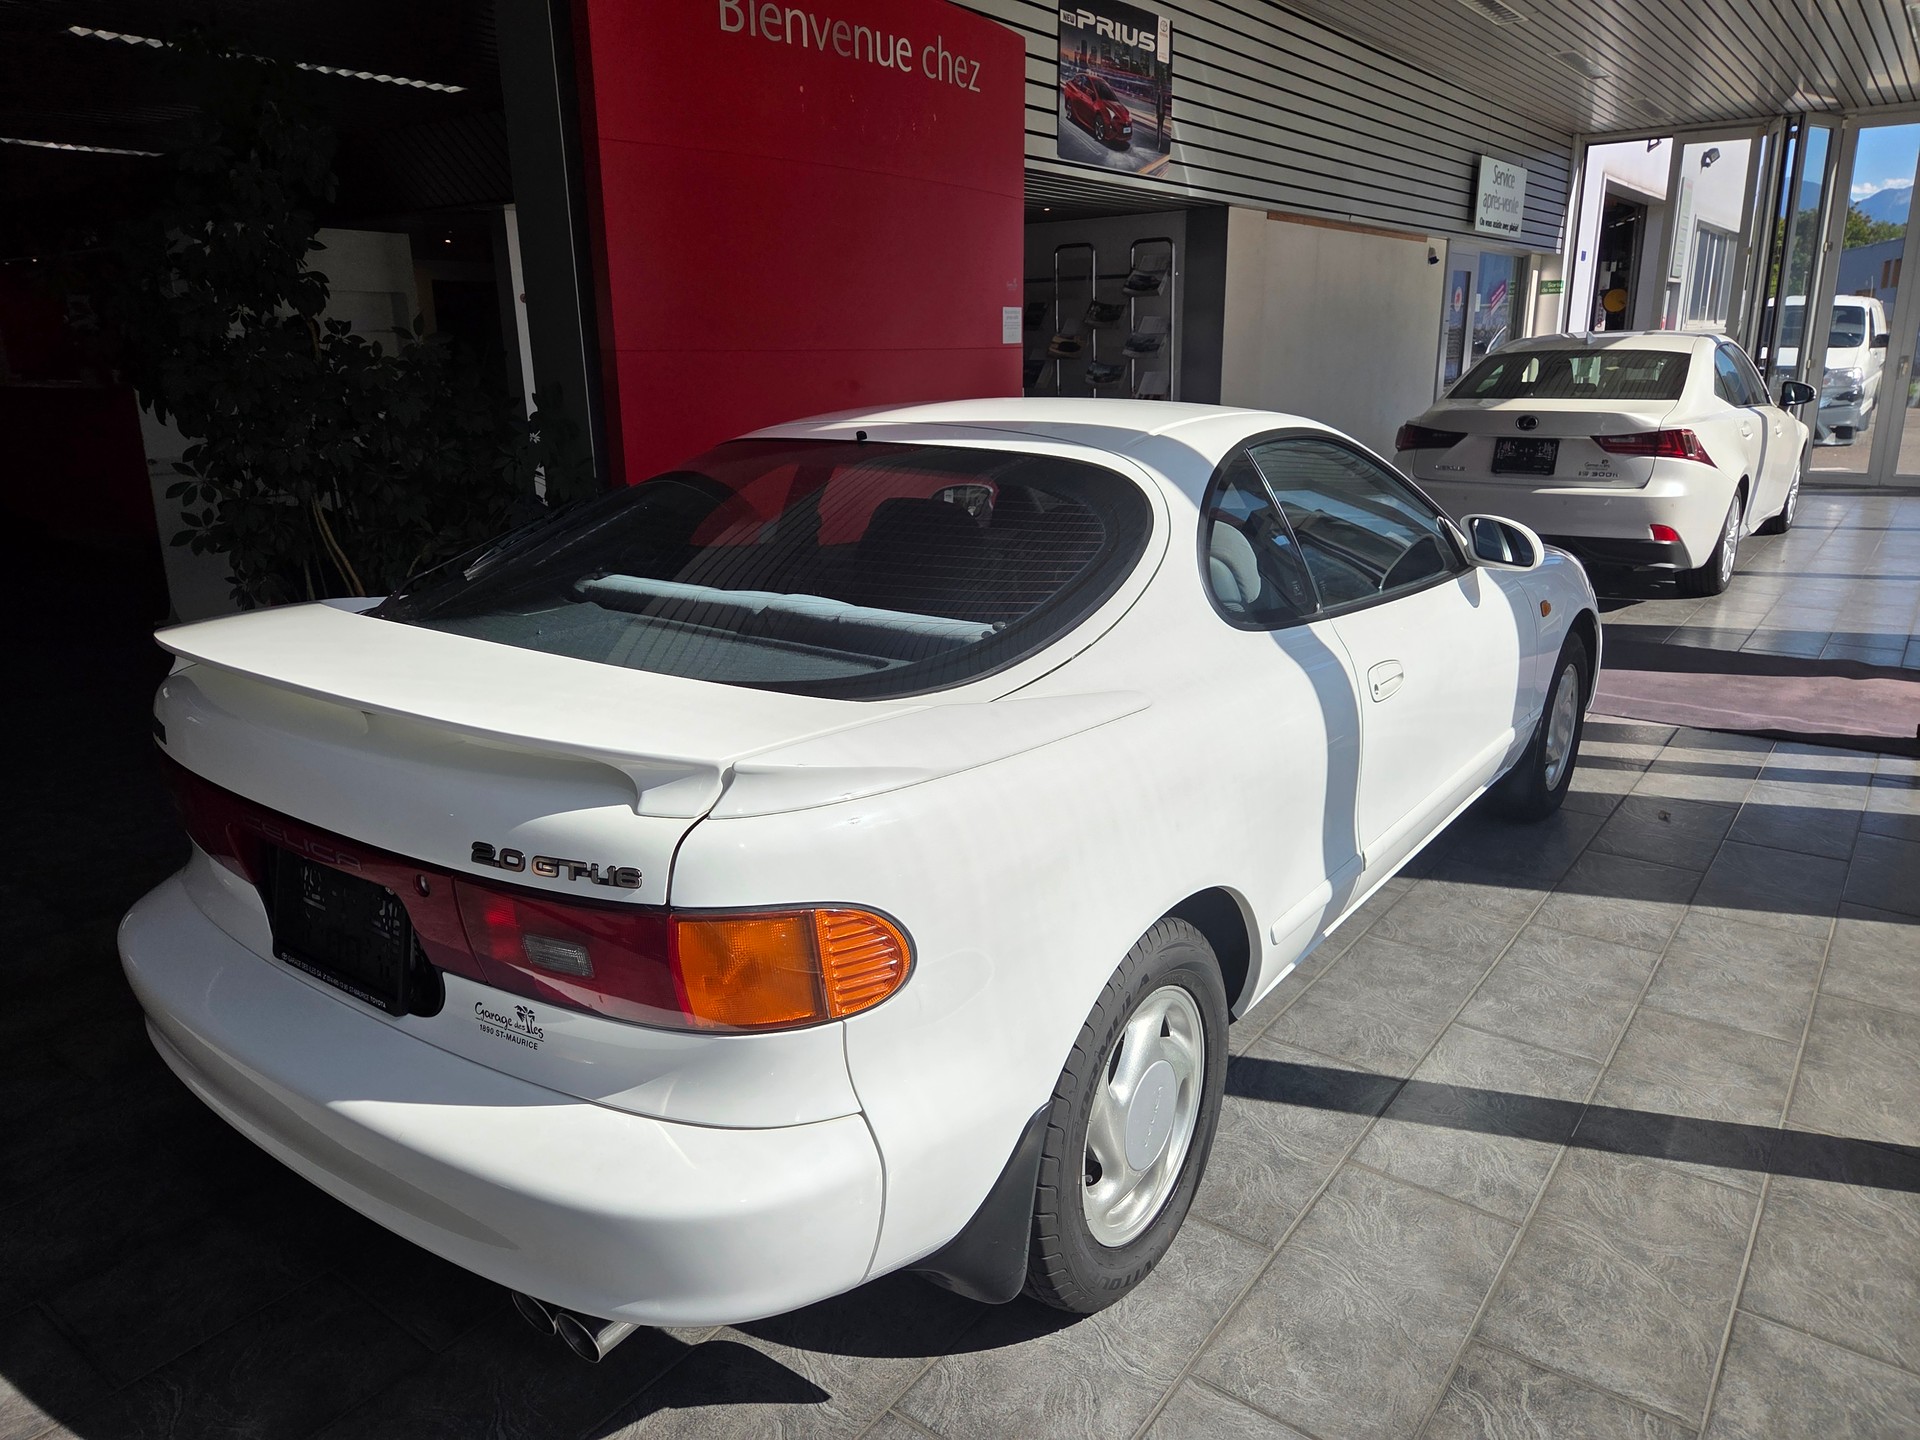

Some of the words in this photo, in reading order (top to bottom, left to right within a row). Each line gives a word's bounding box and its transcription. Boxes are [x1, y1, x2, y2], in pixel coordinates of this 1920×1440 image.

[1062, 12, 1075, 24] NEW
[1076, 8, 1156, 53] PRIUS
[719, 0, 913, 73] Bienvenue
[922, 35, 981, 93] chez
[1492, 164, 1516, 190] Service
[1482, 189, 1520, 215] après-vente
[242, 814, 363, 872] CELICA
[471, 841, 526, 873] 2.0
[474, 1001, 513, 1031] Garage
[513, 1020, 526, 1031] des
[479, 1023, 495, 1036] 1890
[495, 1029, 538, 1051] ST-MAURICE
